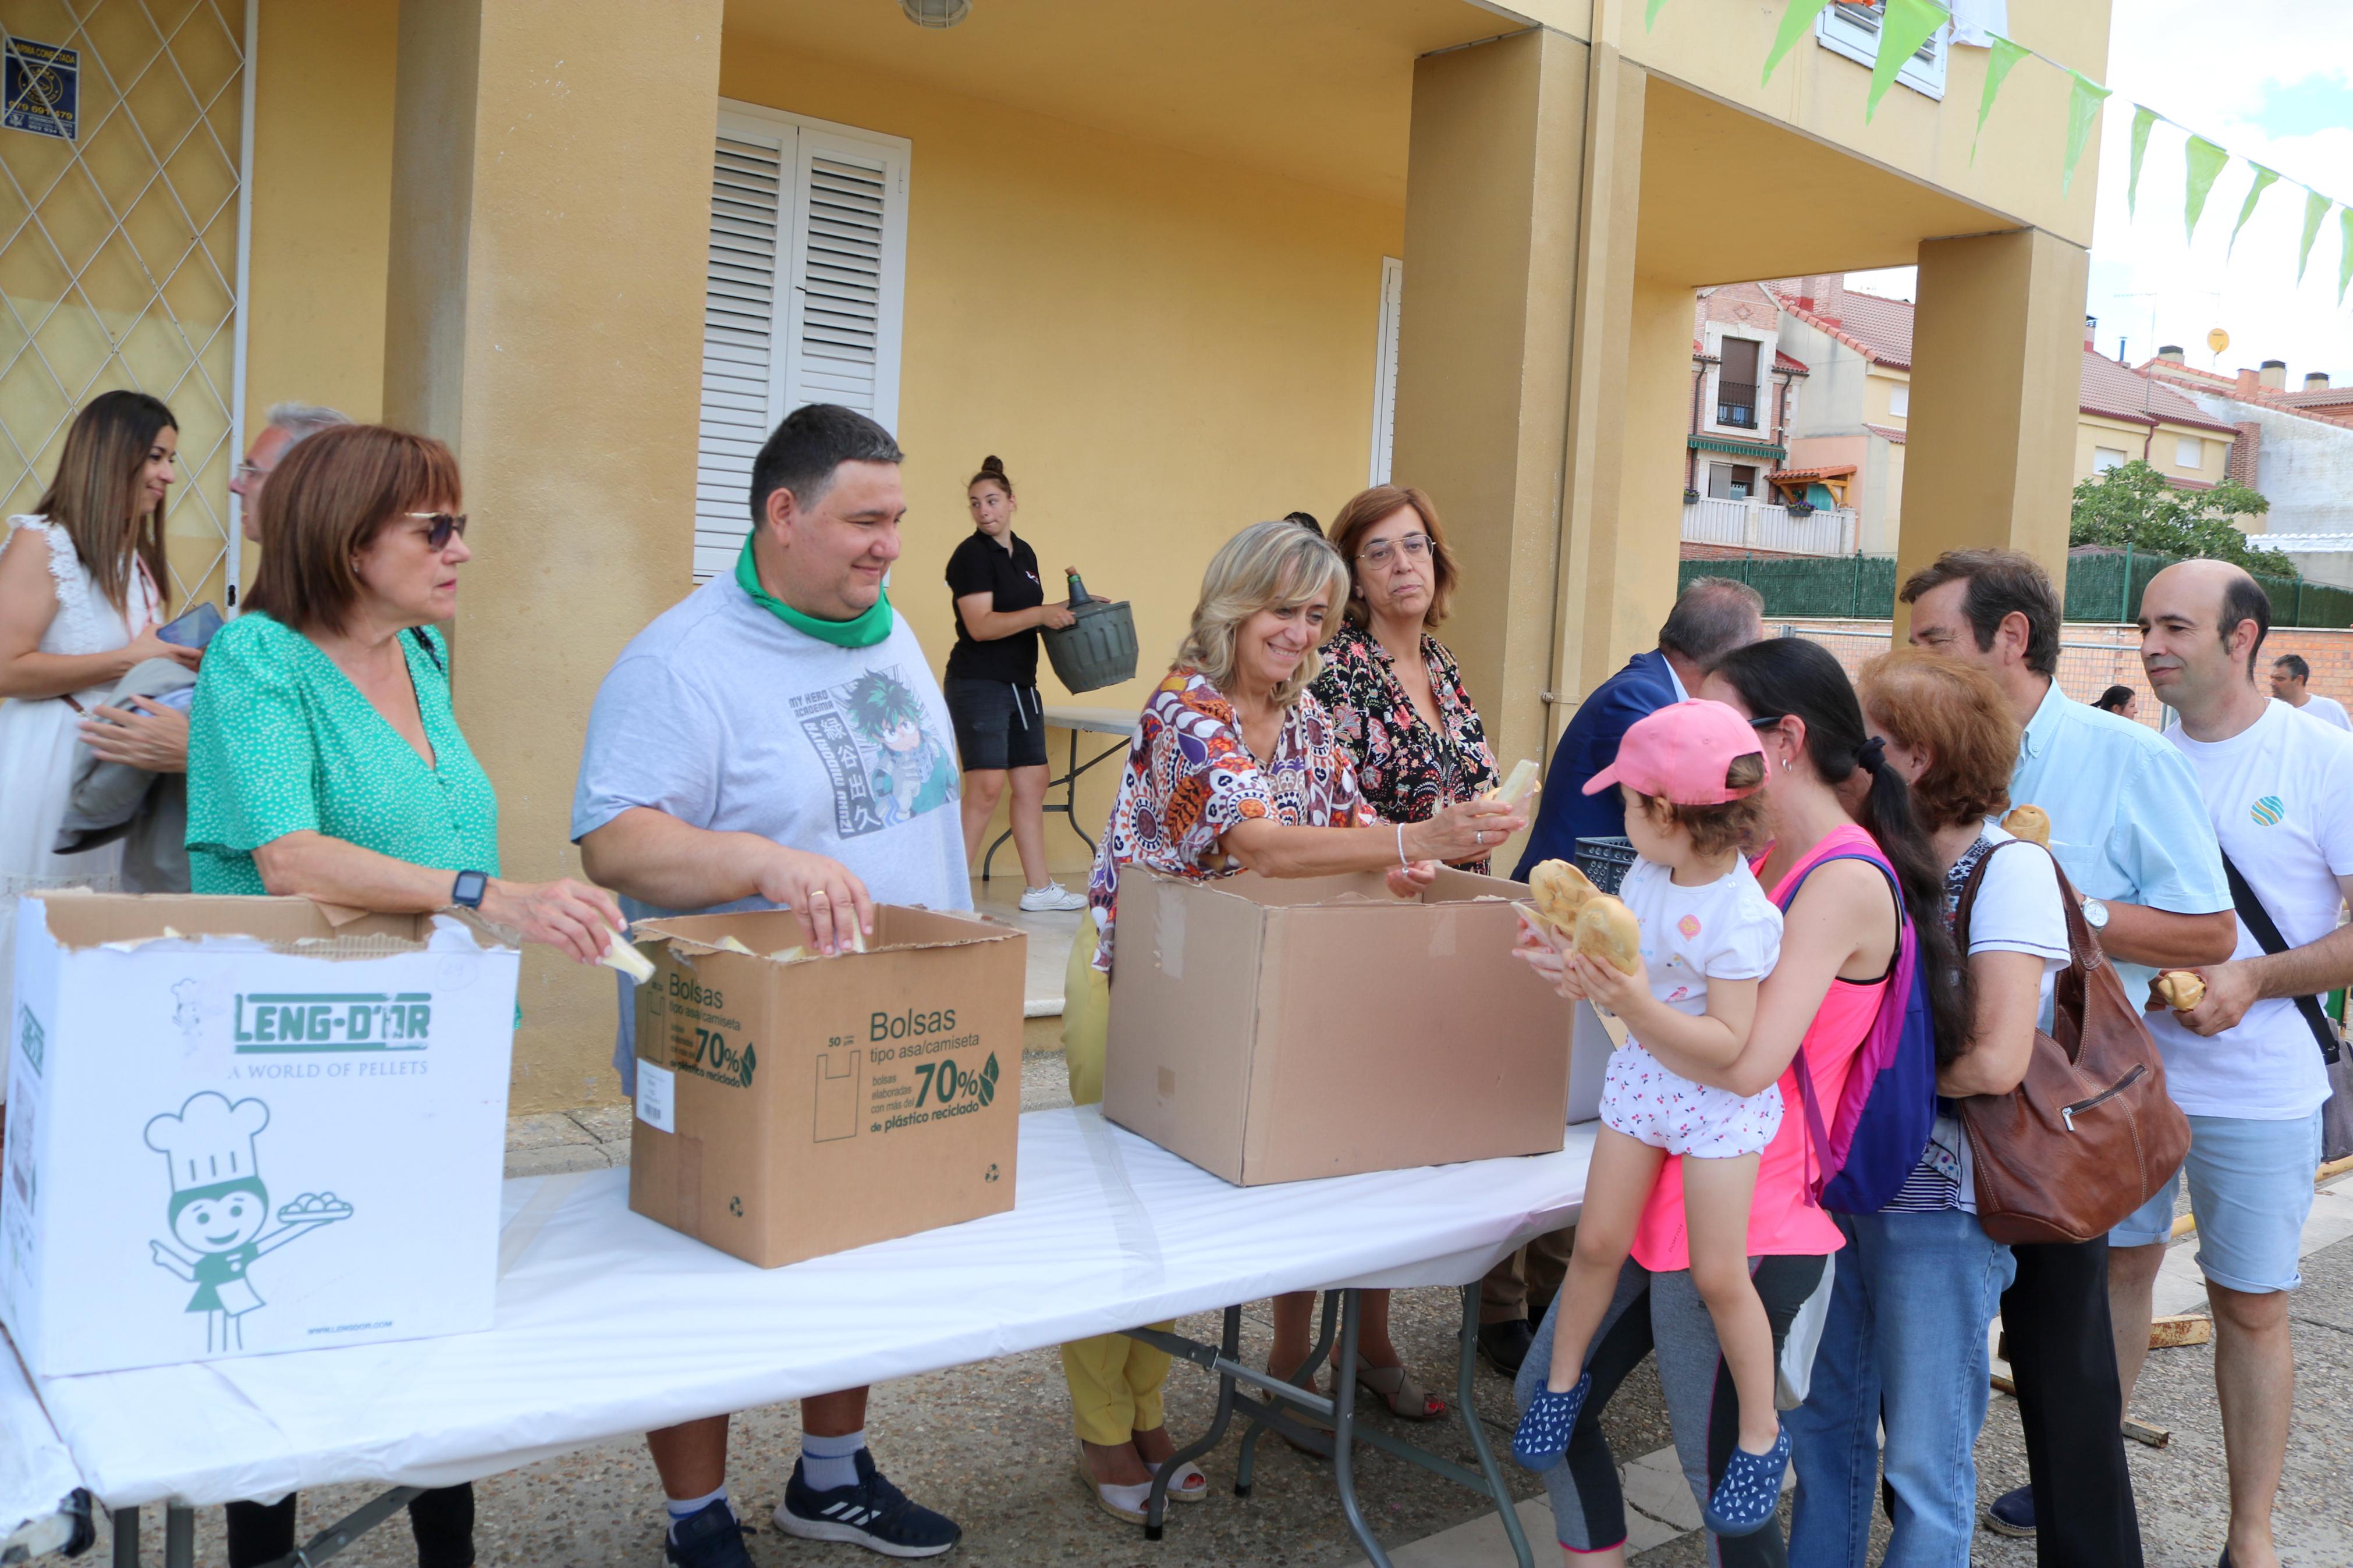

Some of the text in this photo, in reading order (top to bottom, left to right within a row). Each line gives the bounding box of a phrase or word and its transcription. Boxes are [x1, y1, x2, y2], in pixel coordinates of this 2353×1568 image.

[789, 689, 828, 709] MY HERO
[794, 701, 834, 718] ACADEMIA
[803, 722, 844, 787] MIDORIYA
[670, 973, 723, 1009] Bolsas
[234, 993, 431, 1042] LENG-D'OR
[685, 1007, 741, 1031] asa/camiseta
[870, 1008, 956, 1041] Bolsas
[695, 1027, 740, 1073] 70%
[828, 1036, 841, 1047] 50
[870, 1033, 979, 1065] tipo asa/camiseta
[228, 1061, 429, 1079] A WORLD OF PELLETS
[872, 1075, 896, 1086] bolsas
[914, 1059, 978, 1108] 70%
[871, 1096, 914, 1114] con más del
[872, 1085, 912, 1100] elaboradas
[871, 1100, 979, 1133] de plástico reciclado
